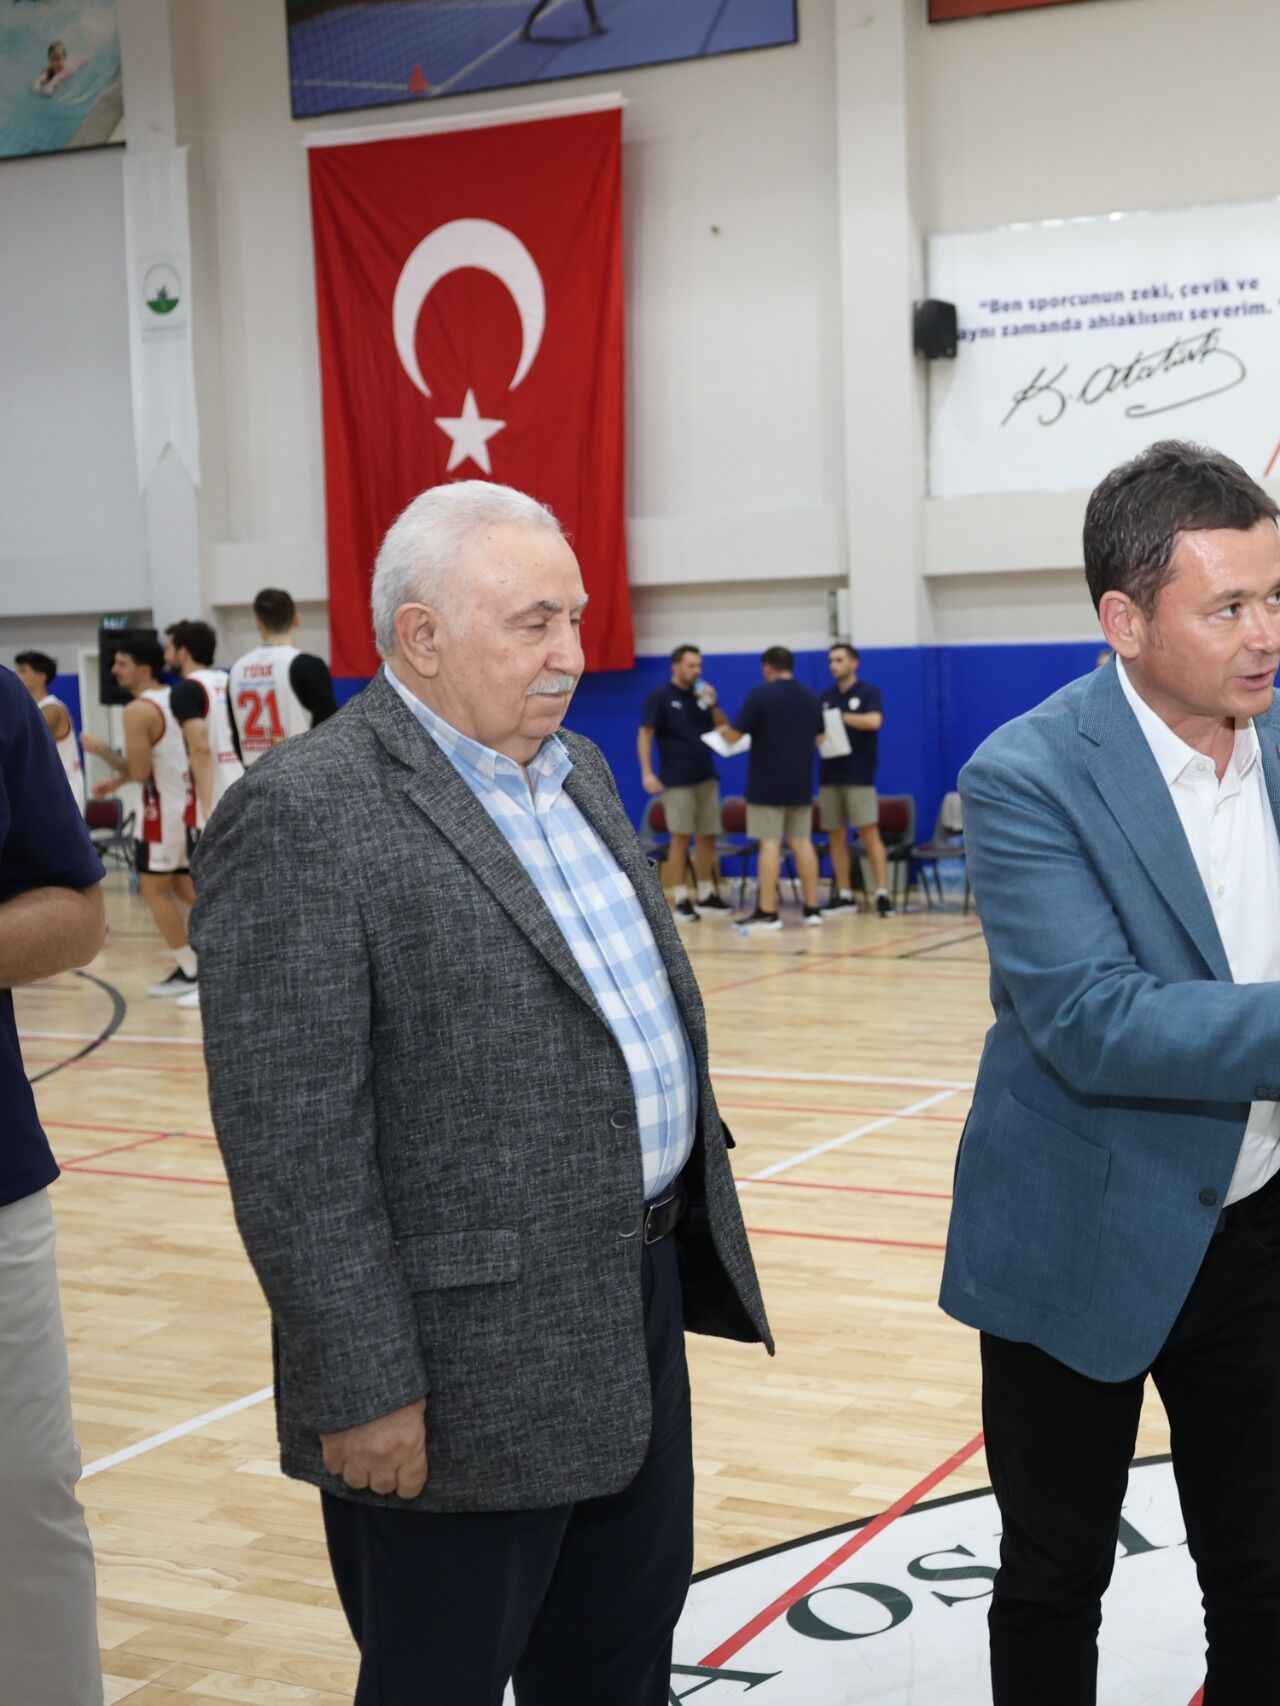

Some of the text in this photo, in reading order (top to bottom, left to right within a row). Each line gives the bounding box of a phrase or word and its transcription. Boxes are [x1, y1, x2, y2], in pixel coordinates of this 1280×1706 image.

[1028, 289, 1125, 312] sporcunun
[1130, 282, 1175, 301] zeki,
[1179, 276, 1231, 299] çevik
[1236, 277, 1259, 292] ve
[956, 326, 996, 342] aynı
[1001, 316, 1082, 338] zamanda
[1088, 306, 1184, 330] ahlaklısını
[236, 688, 285, 738] 21
